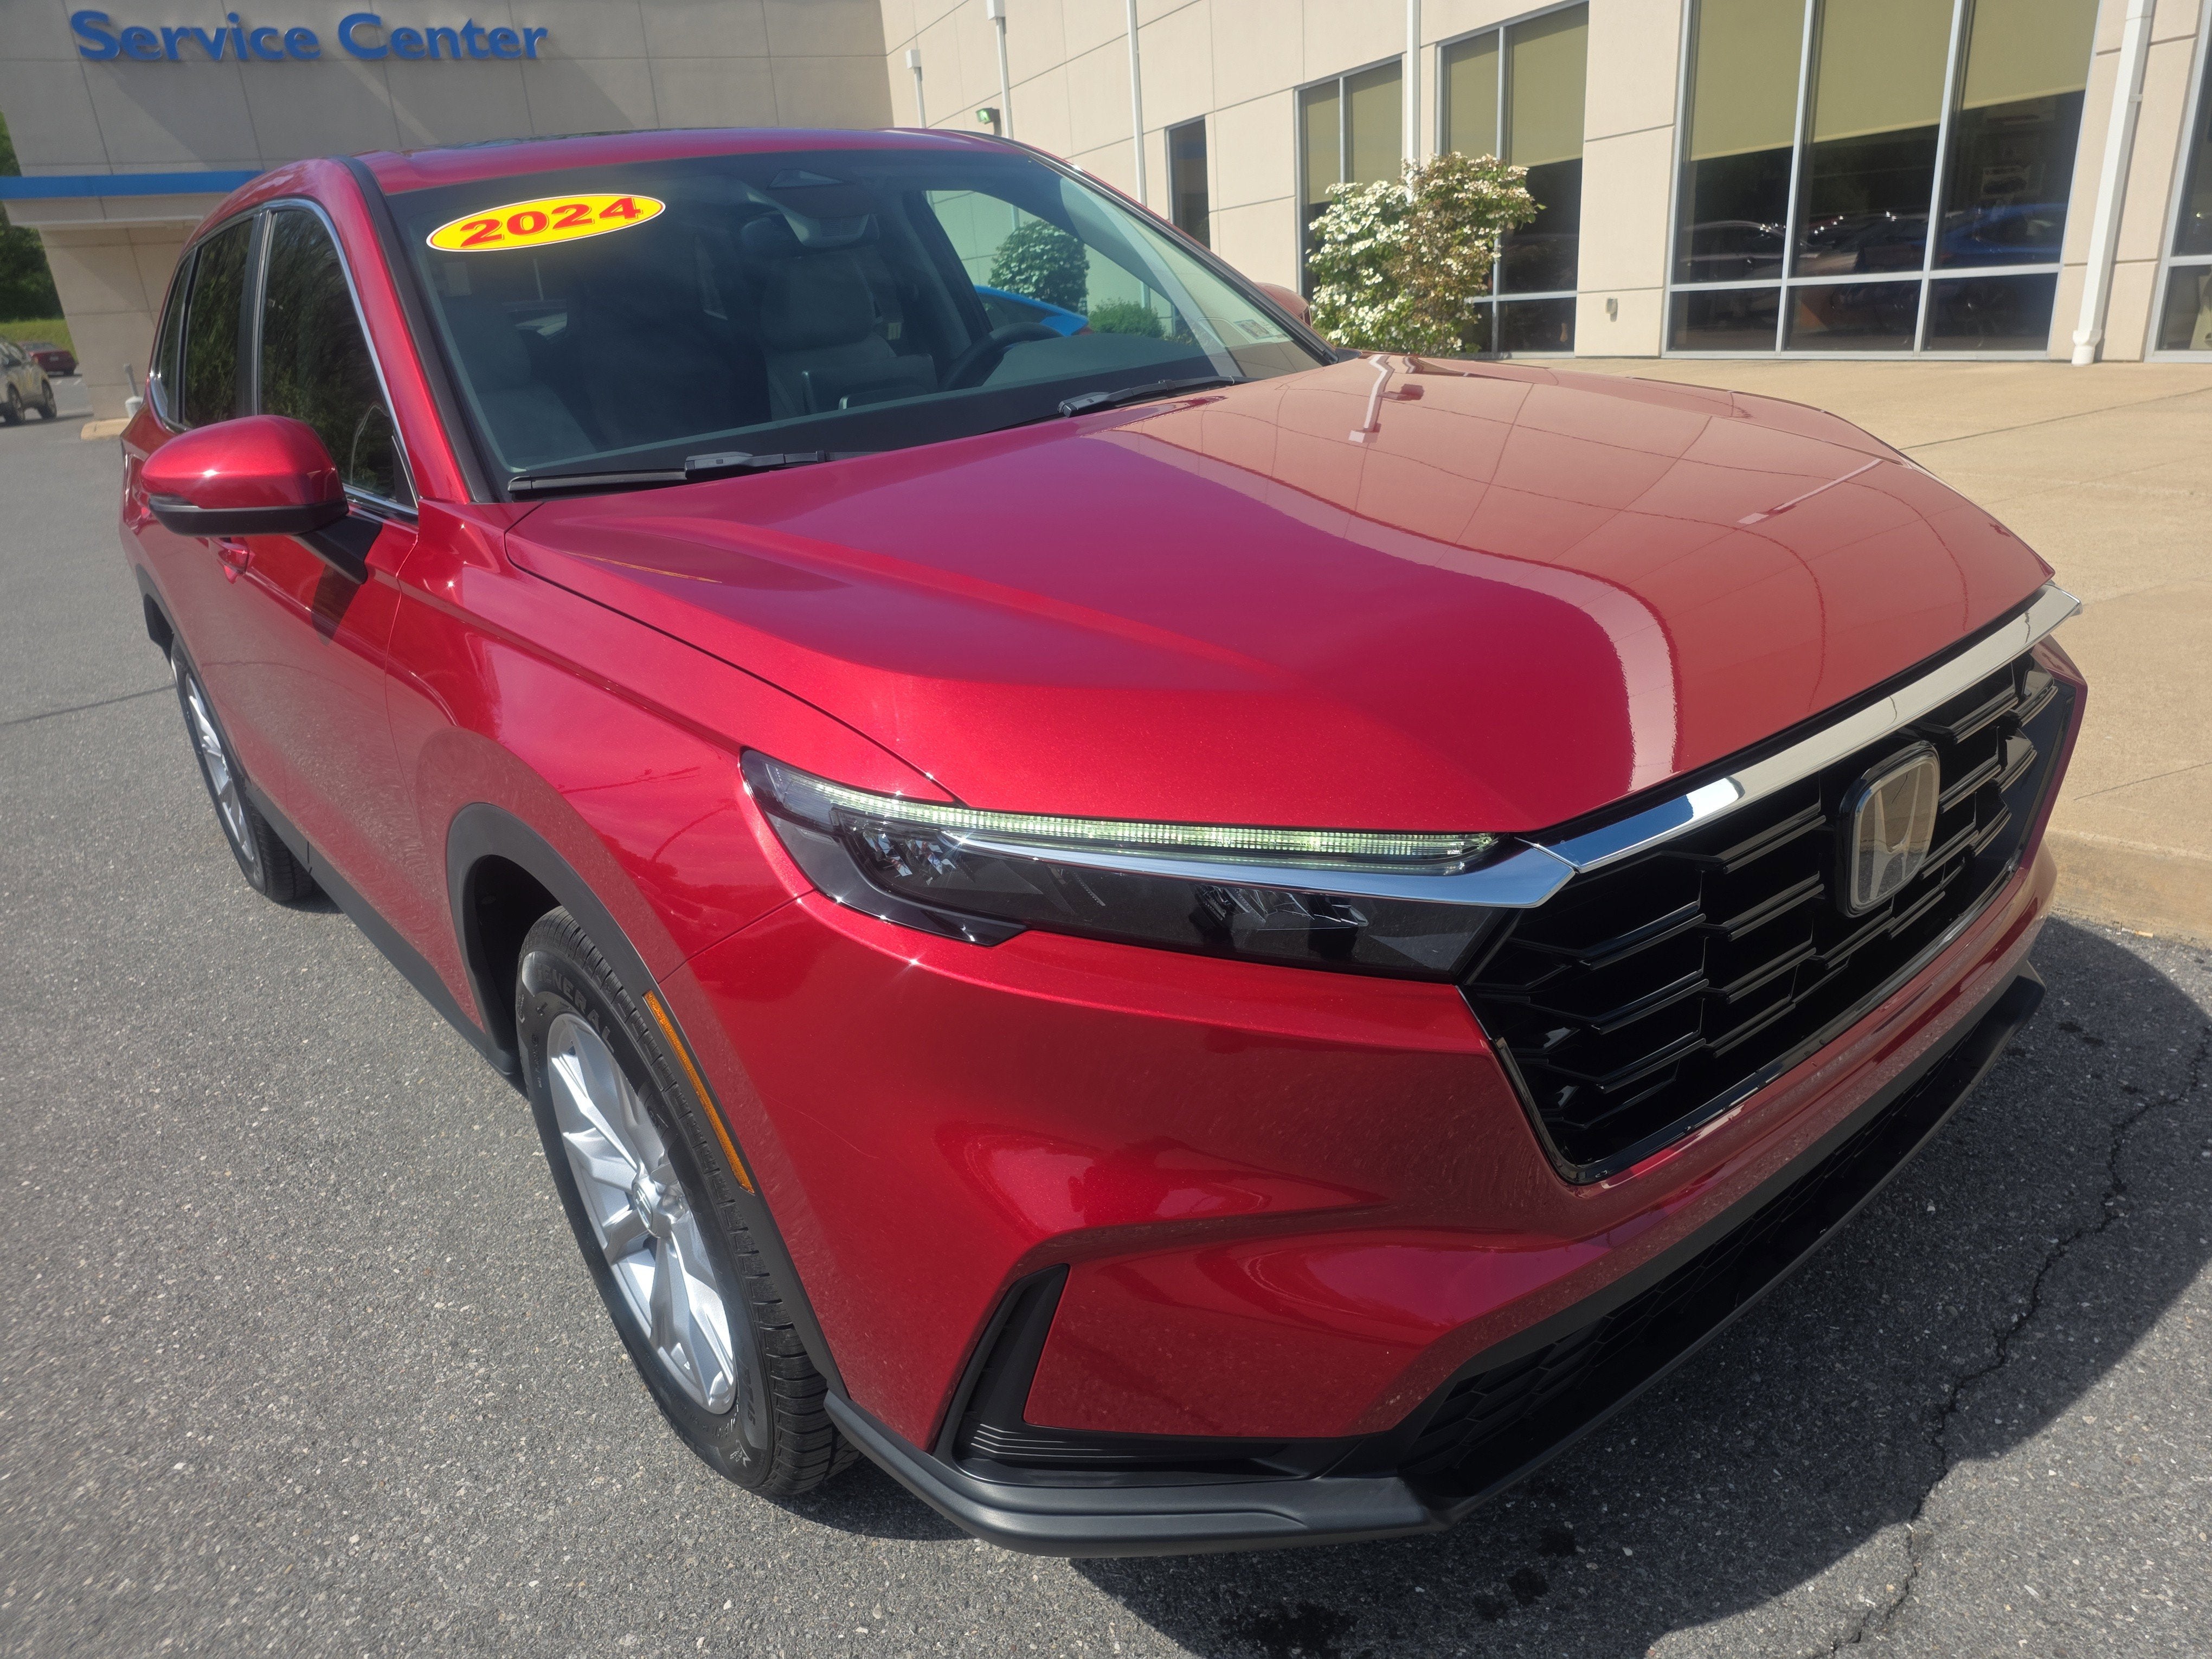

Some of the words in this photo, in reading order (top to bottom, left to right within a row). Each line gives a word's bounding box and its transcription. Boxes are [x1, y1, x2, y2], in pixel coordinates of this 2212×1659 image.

[70, 10, 322, 60] Service
[338, 12, 548, 60] Center
[460, 197, 643, 248] 2024
